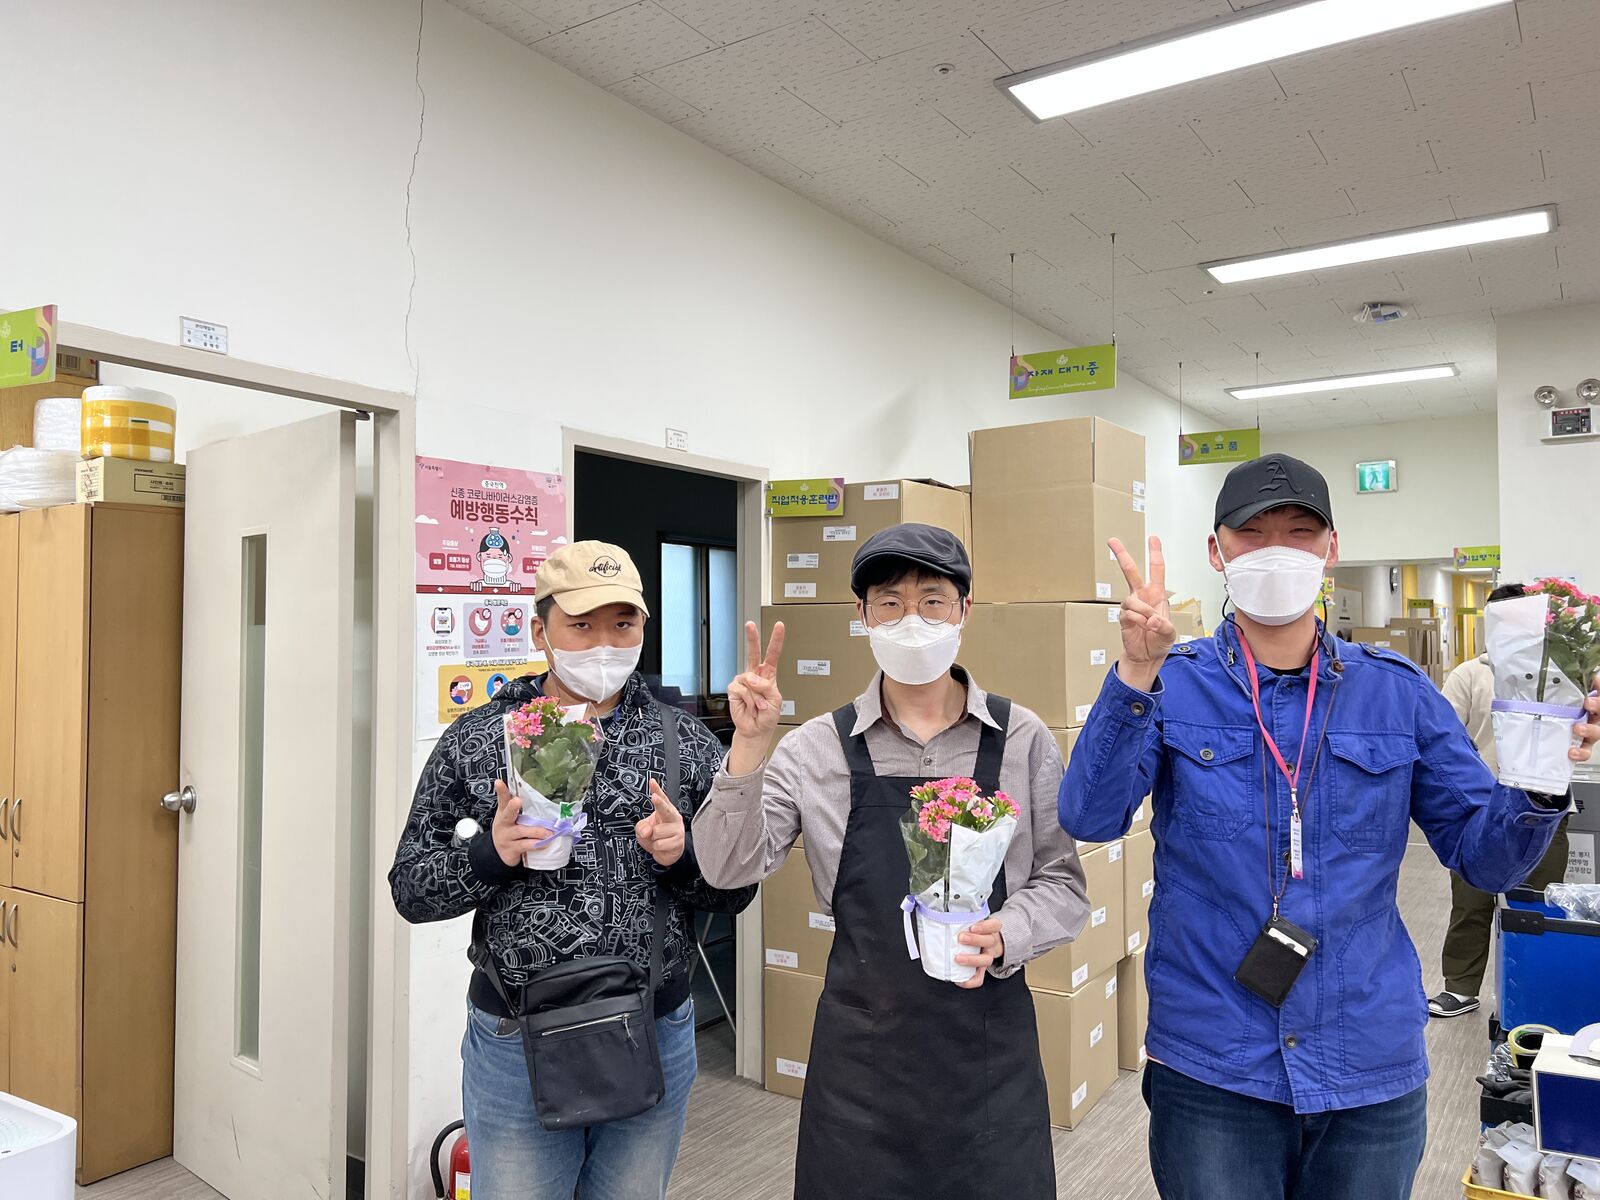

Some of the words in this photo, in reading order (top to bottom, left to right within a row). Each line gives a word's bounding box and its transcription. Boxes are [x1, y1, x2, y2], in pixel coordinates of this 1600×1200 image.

[10, 339, 24, 353] 터
[1027, 369, 1053, 378] 자재
[1058, 361, 1100, 377] 대기중
[1200, 441, 1238, 455] 출고품
[450, 487, 465, 499] 신종
[467, 489, 538, 506] 코로나바이러스감염증
[771, 494, 838, 506] 직업적용훈련반
[450, 499, 539, 527] 예방행동수칙
